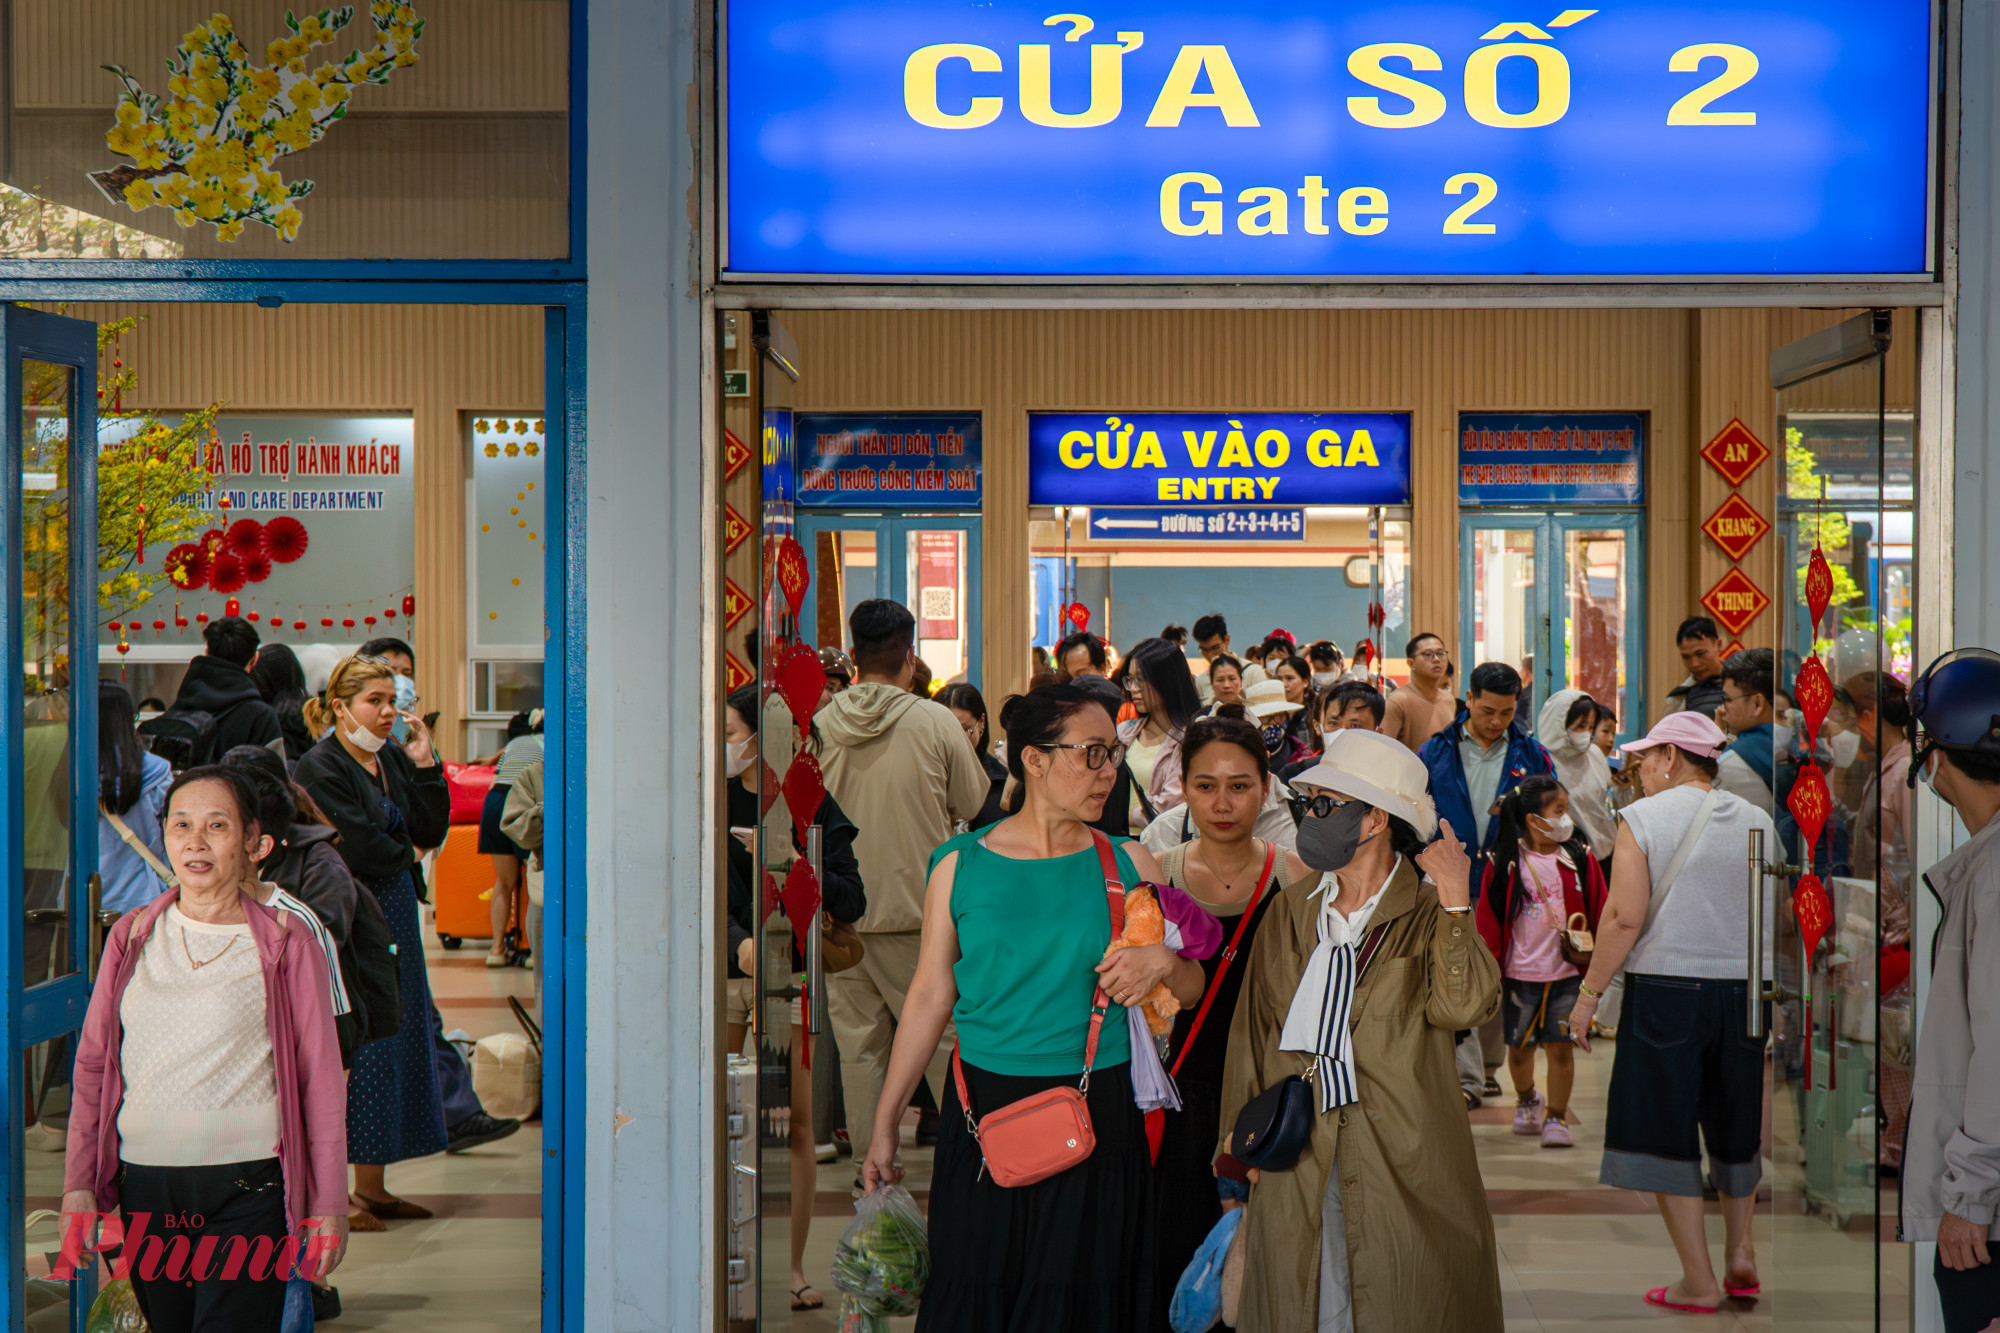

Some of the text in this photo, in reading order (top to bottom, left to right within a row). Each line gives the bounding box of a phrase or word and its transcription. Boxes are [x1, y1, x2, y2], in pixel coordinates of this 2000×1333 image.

[904, 10, 1758, 128] CỬA SỐ 2
[1160, 172, 1496, 235] Gate 2
[816, 429, 854, 455] NGƯỜI
[856, 430, 888, 455] THÂN
[890, 433, 902, 455] ĐI
[1058, 416, 1380, 470] CỬA VÀO GA
[1495, 430, 1506, 450] GA
[232, 432, 251, 475] HỖ
[259, 438, 290, 480] TRỢ
[297, 438, 340, 475] HÀNH
[346, 438, 399, 475] KHÁCH
[1723, 443, 1749, 462] AN
[838, 465, 876, 491] TRƯỚC
[914, 461, 944, 491] KIỂM
[1461, 464, 1475, 484] THE
[1476, 464, 1494, 484] GATE
[1495, 464, 1523, 484] CLOSES
[1531, 464, 1564, 484] MINUTES
[1565, 464, 1592, 484] BEFORE
[219, 491, 246, 509] AND
[252, 491, 287, 509] CARE
[293, 491, 384, 509] DEPARTMENT
[1157, 477, 1280, 500] ENTRY
[1161, 511, 1301, 533] ĐƯỜNG SỐ 2+3+4+5
[1717, 518, 1756, 537] KHANG
[1716, 592, 1755, 616] THỊNH
